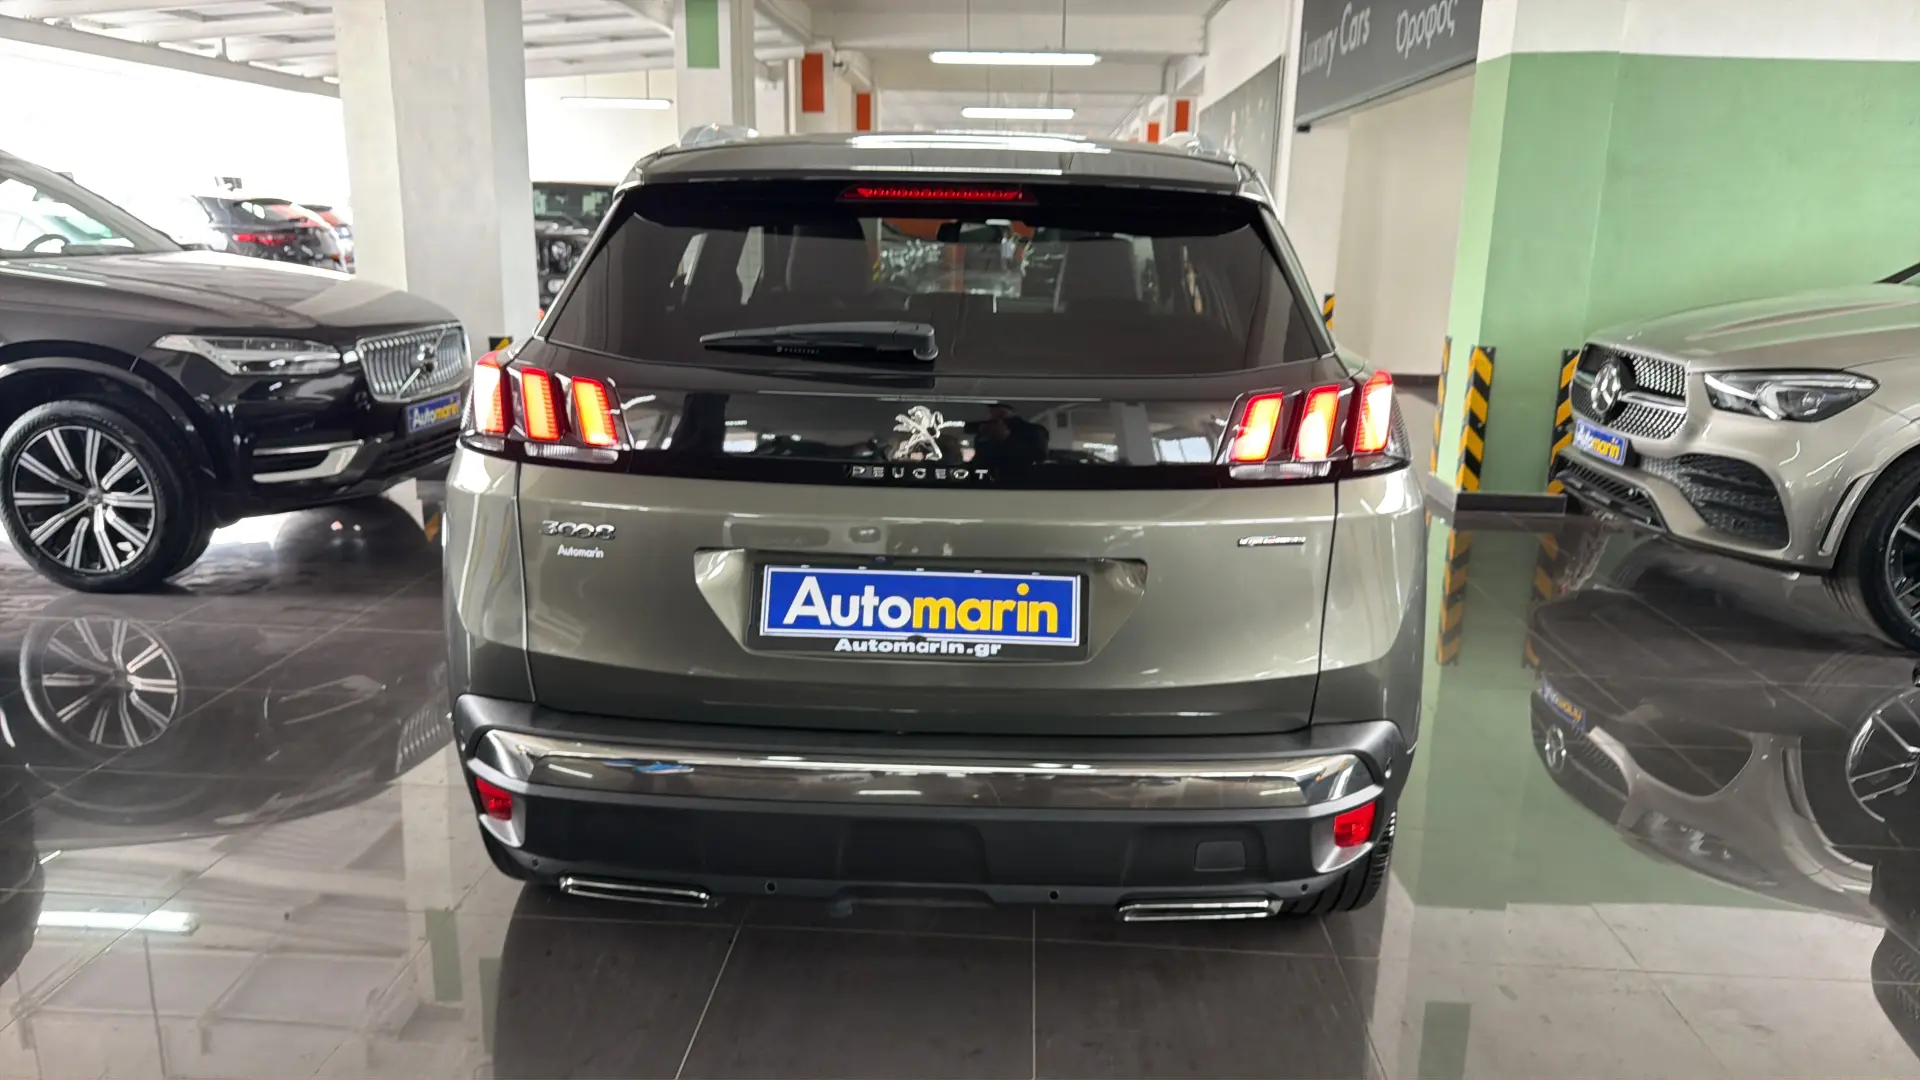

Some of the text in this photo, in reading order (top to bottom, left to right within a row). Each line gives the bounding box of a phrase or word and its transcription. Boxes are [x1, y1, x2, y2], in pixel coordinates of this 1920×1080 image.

[1340, 1, 1371, 55] Cars
[852, 465, 989, 480] PEUGEOT
[541, 520, 616, 540] 3008
[557, 544, 604, 558] Automarin
[783, 575, 1059, 633] Automarin
[834, 638, 1002, 658] Automarin.gr
